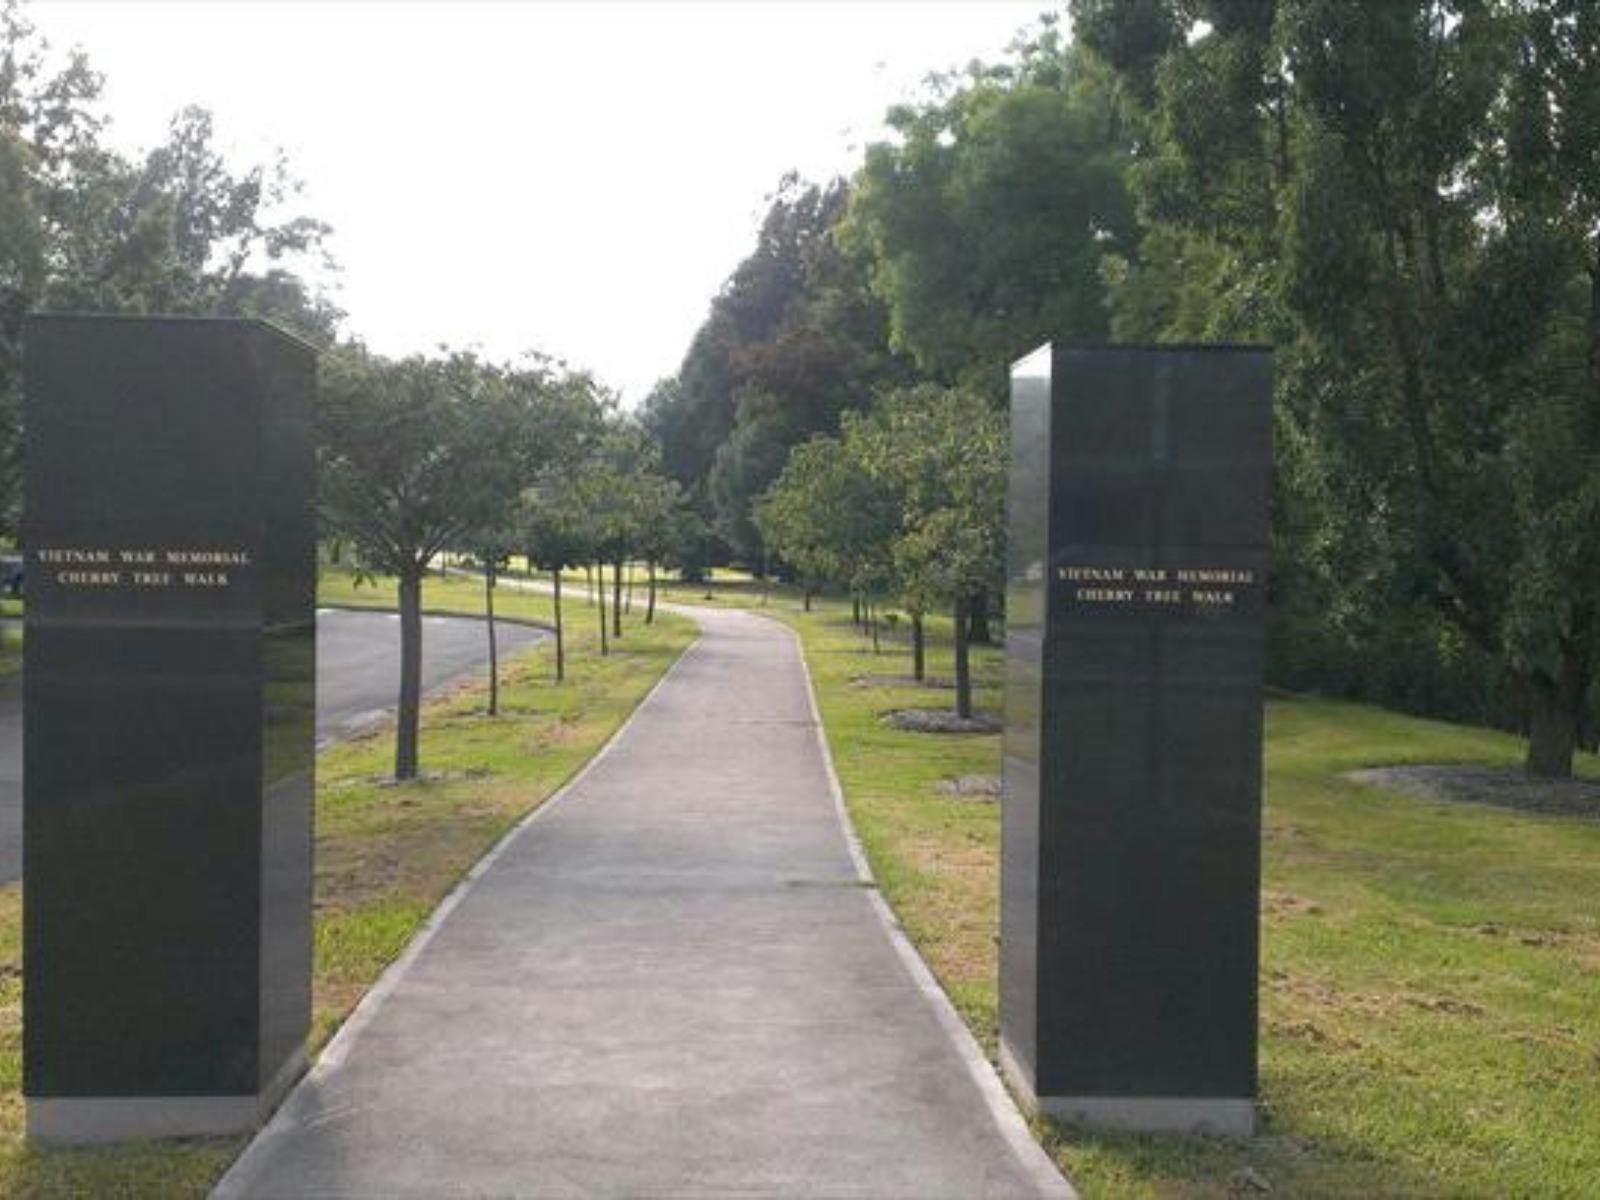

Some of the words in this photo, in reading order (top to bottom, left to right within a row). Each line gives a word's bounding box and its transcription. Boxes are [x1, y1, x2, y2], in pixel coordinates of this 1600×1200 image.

[36, 550, 111, 563] VIETNAM
[119, 551, 155, 563] WAR
[166, 551, 250, 564] MEMORIAL
[56, 571, 120, 584] CHERRY
[133, 572, 170, 585] TREE
[183, 572, 229, 586] WALK
[1058, 567, 1124, 581] VIETNAM
[1133, 568, 1167, 581] WAR
[1177, 569, 1254, 583] MEMORIAL
[1076, 588, 1134, 602] CHERRY
[1145, 590, 1181, 603] TREE
[1191, 590, 1234, 604] WALK
